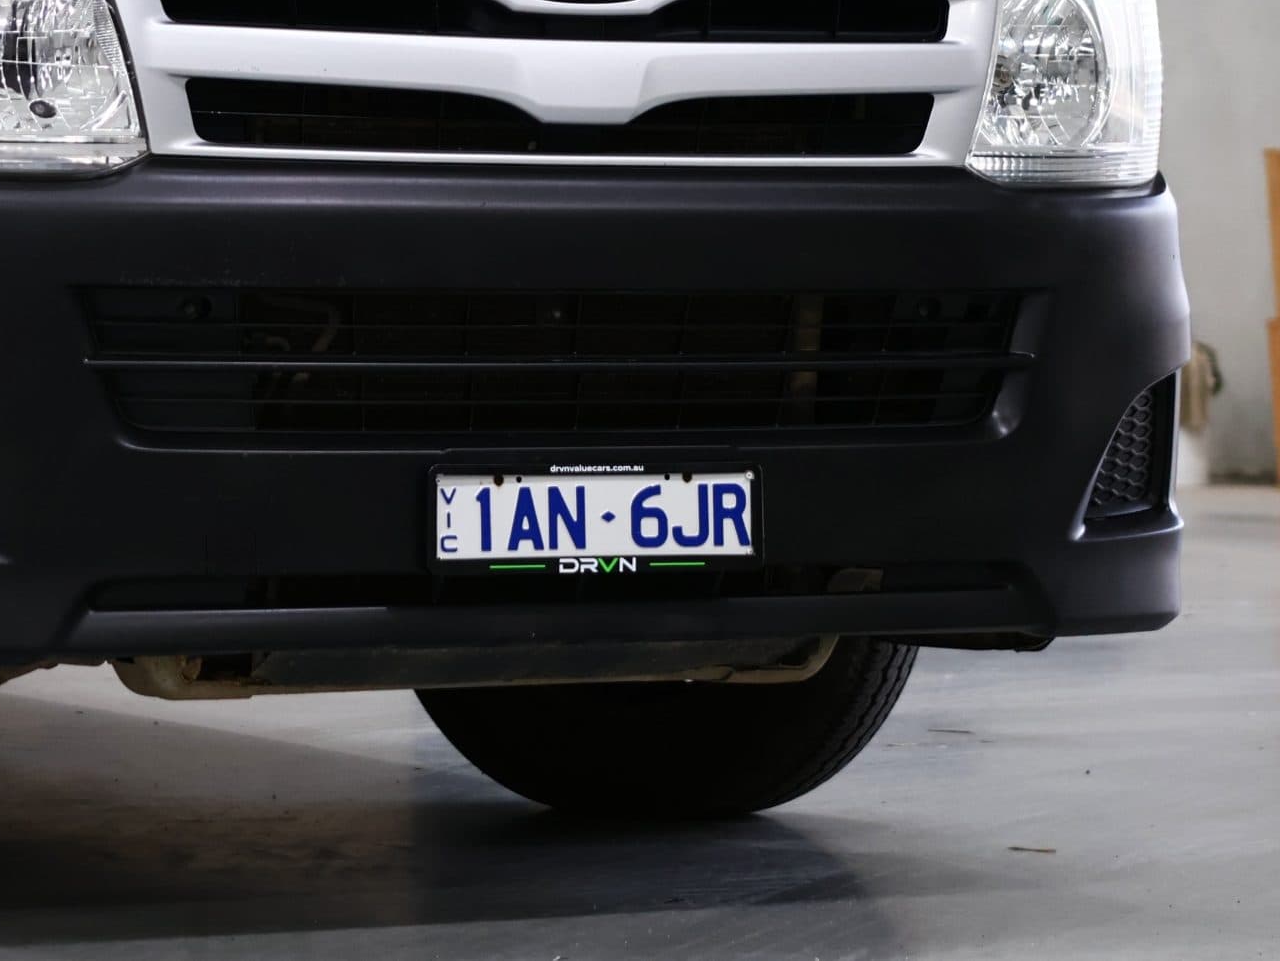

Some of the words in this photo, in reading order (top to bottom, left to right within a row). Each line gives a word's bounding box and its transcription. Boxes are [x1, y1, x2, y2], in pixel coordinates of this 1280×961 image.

[550, 464, 644, 472] drvnvaluecars.com.au
[440, 488, 458, 552] VIC
[559, 557, 637, 573] DRVN
